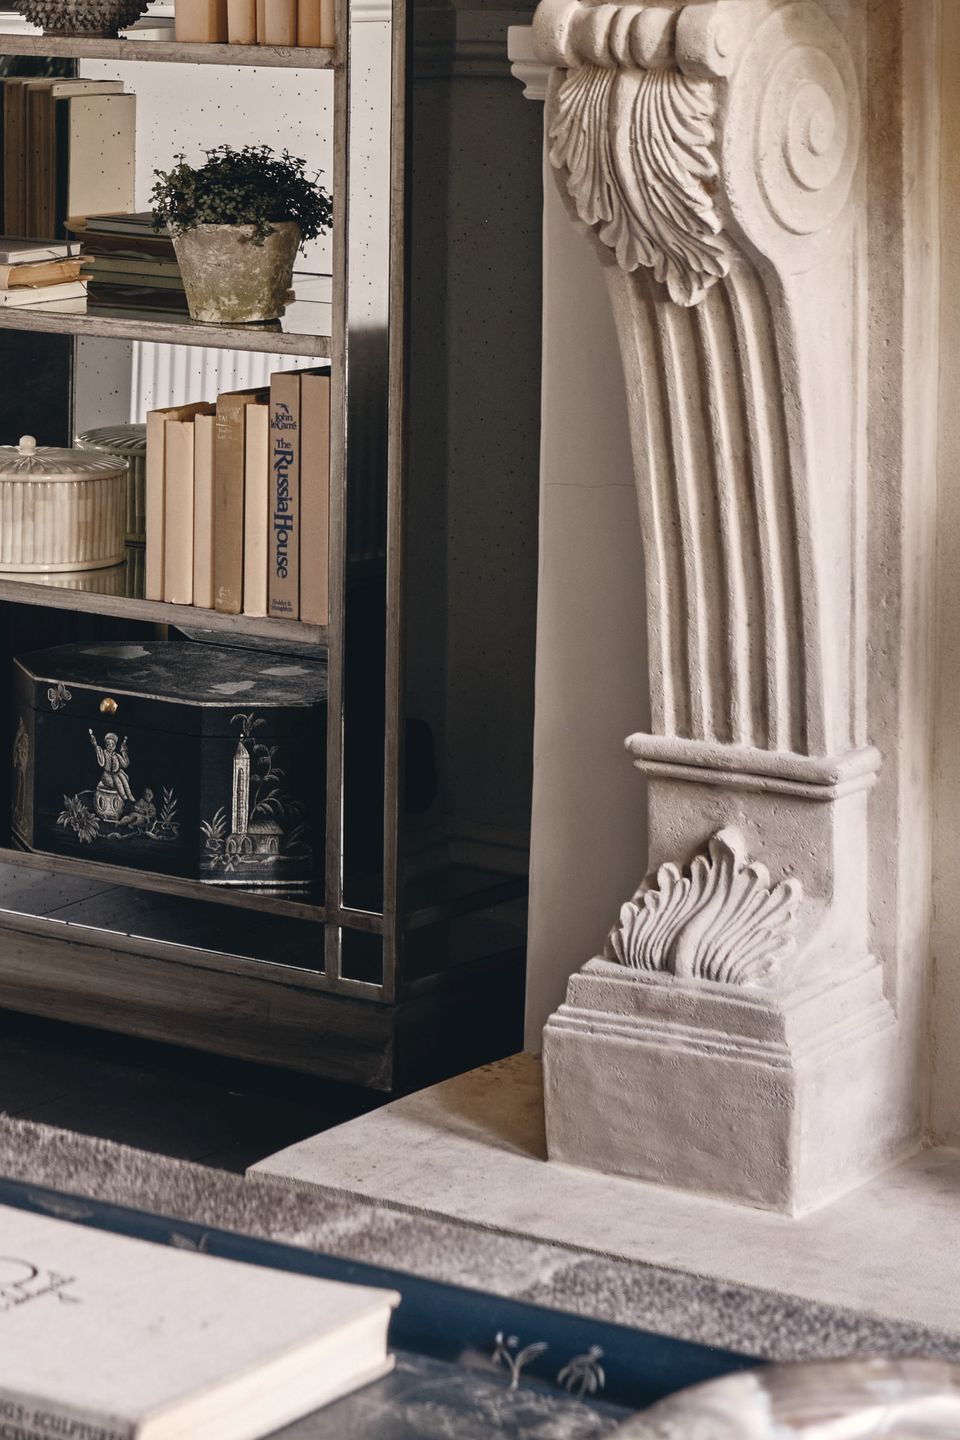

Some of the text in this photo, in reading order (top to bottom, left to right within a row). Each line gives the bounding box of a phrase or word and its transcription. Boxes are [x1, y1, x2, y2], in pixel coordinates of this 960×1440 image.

[275, 412, 293, 421] John
[275, 438, 292, 448] The
[273, 447, 294, 579] Russia House
